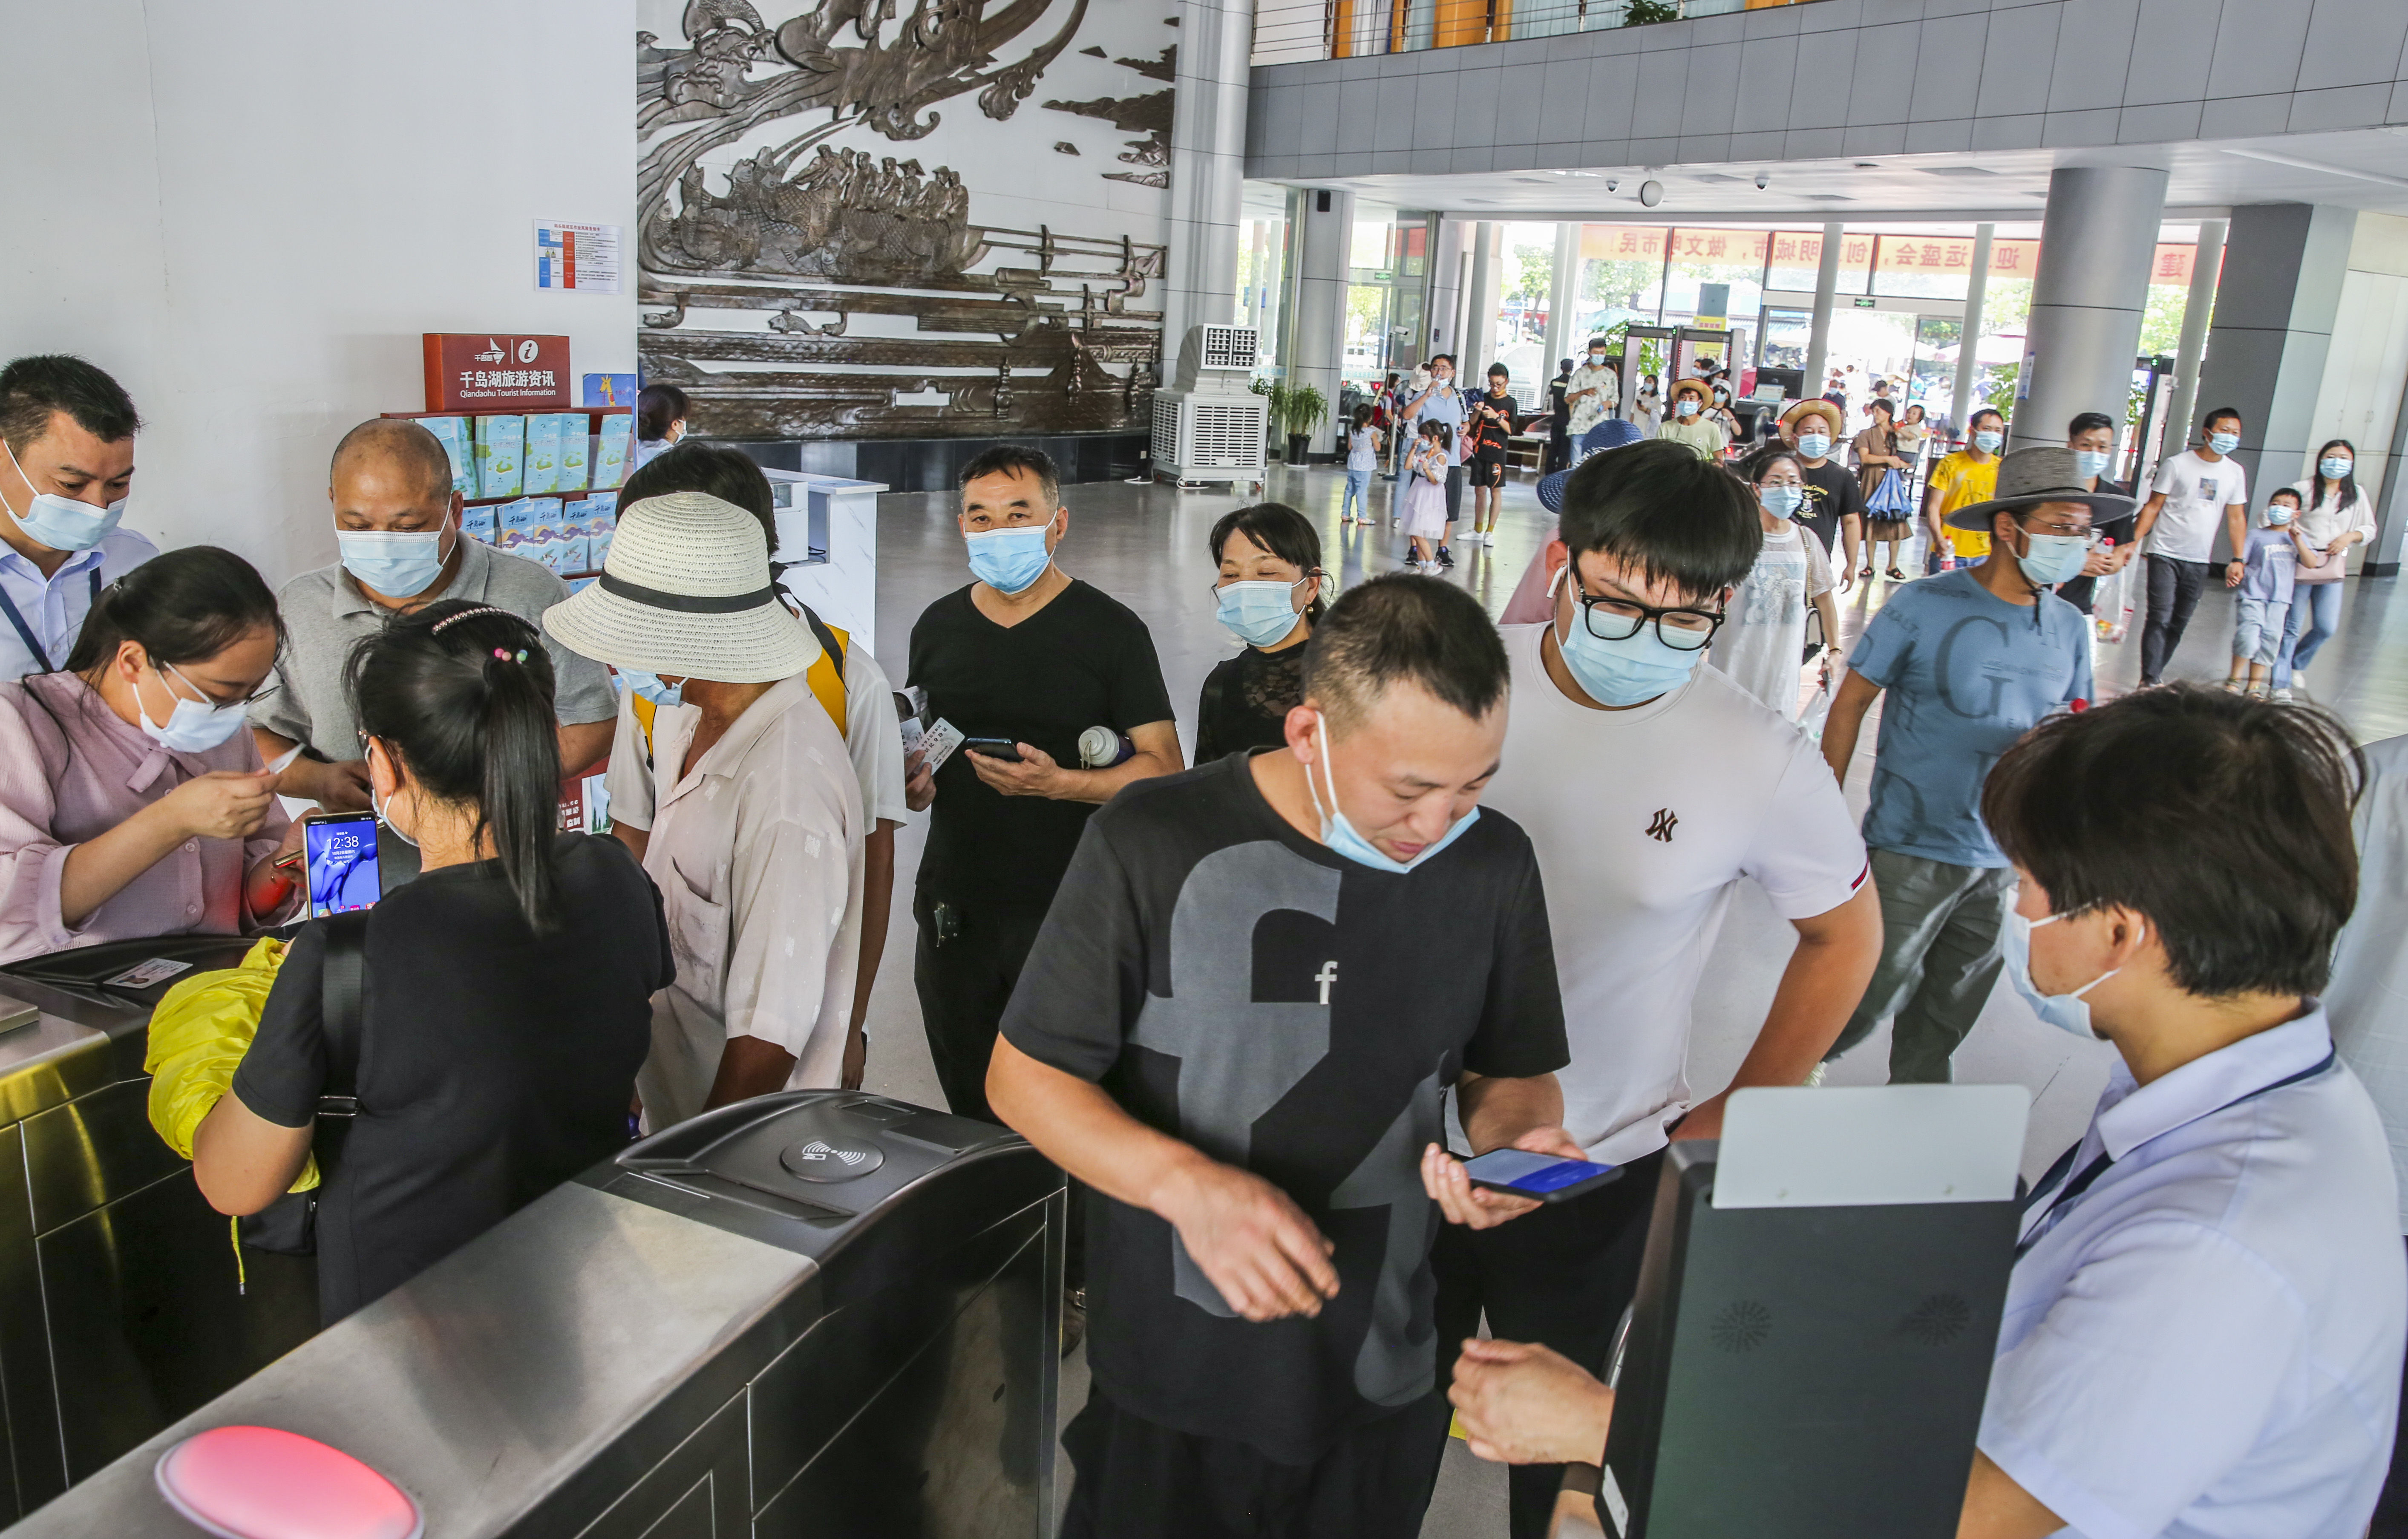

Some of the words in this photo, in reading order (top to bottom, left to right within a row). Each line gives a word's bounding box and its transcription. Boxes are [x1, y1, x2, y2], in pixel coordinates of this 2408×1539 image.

[460, 370, 556, 389] 千岛湖旅游资讯
[460, 389, 496, 398] Qiandaohu
[497, 388, 518, 397] Tourist
[520, 388, 556, 396] Information
[1935, 615, 2010, 719] G
[567, 816, 581, 828] 监制
[1645, 807, 1679, 843] NY
[326, 836, 359, 850] 12:38
[1315, 960, 1338, 1005] f
